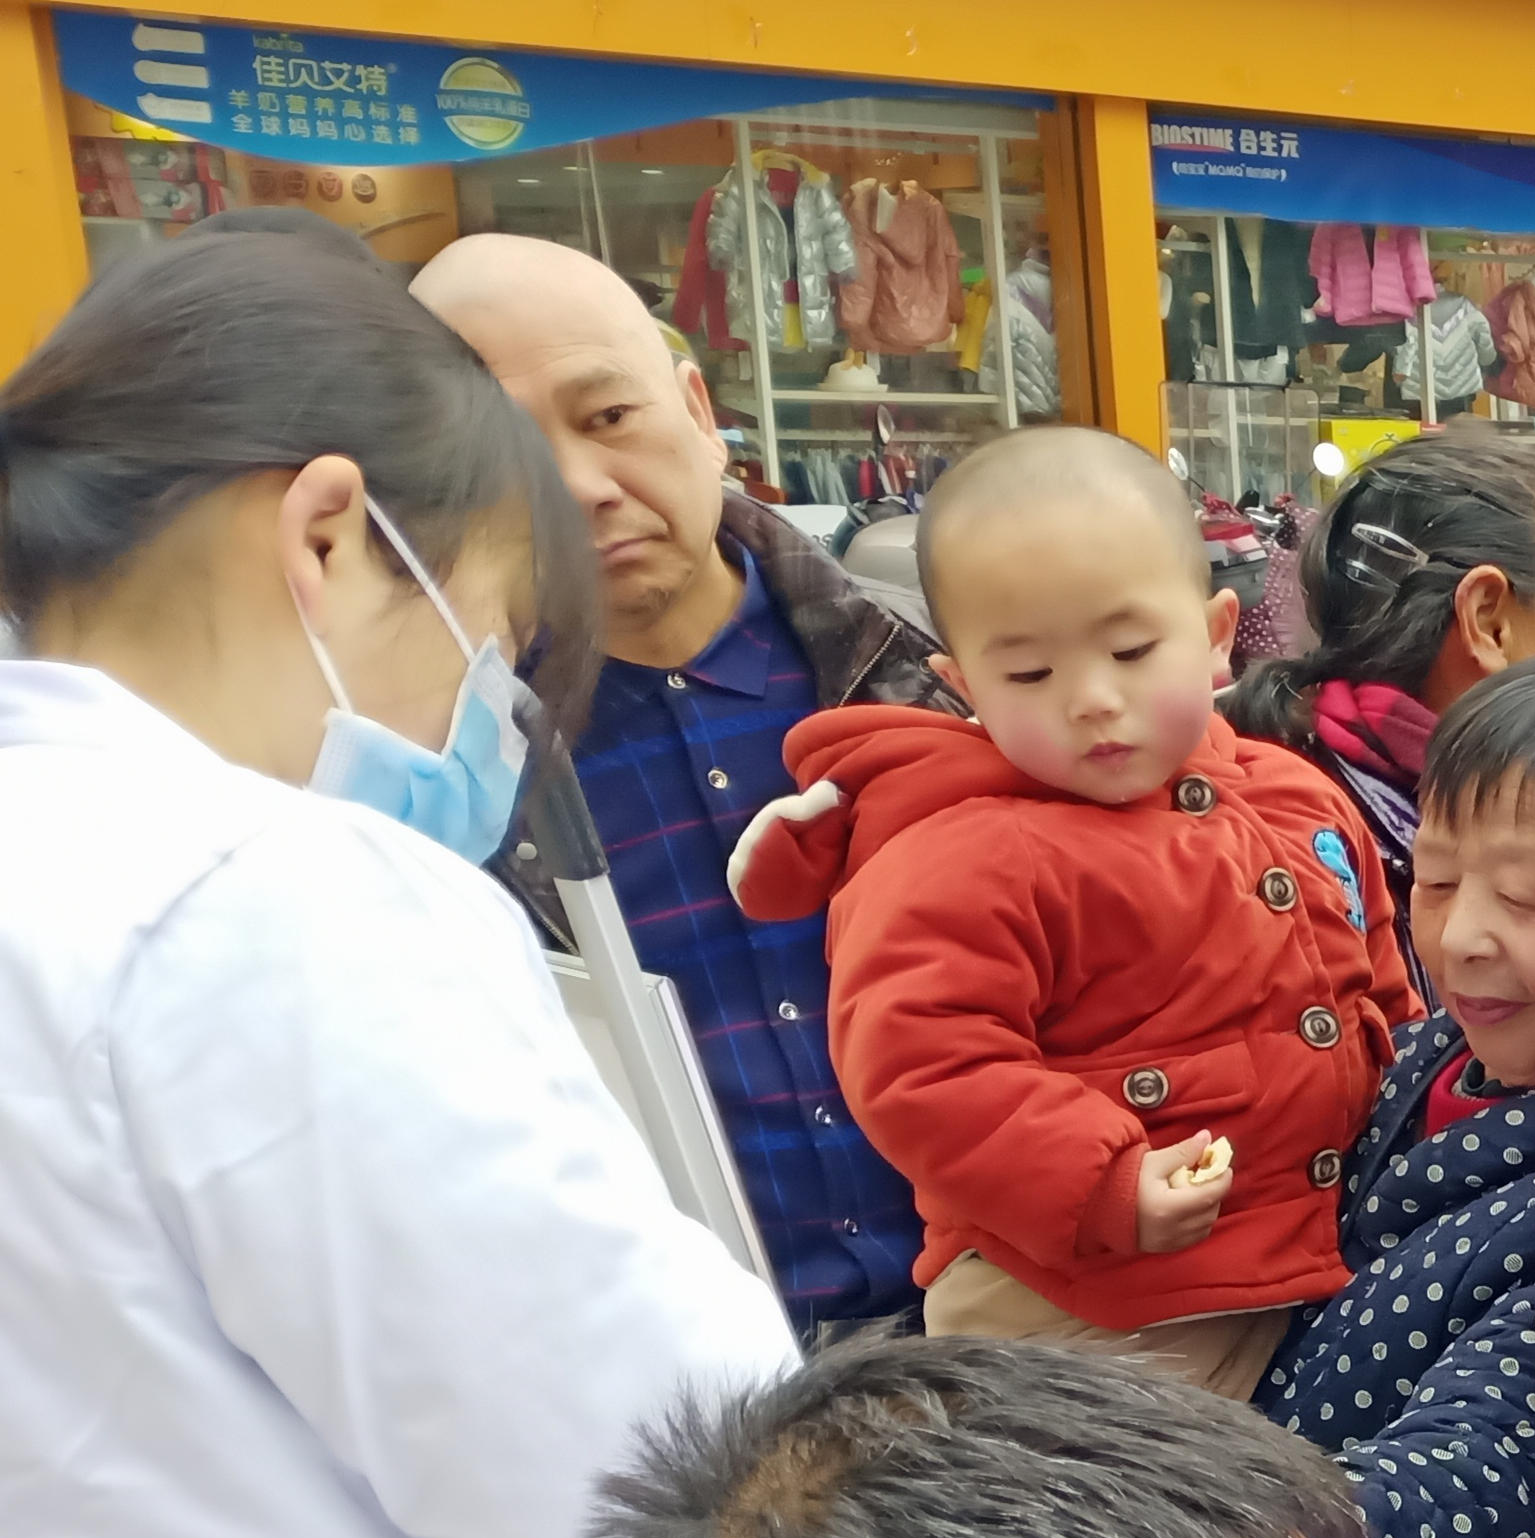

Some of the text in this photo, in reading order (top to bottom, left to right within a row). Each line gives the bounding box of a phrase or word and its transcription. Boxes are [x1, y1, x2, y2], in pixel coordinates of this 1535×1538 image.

[252, 54, 388, 96] 佳贝艾特
[228, 88, 418, 124] 羊奶营养高标准
[230, 112, 420, 145] 全球妈妈心选择
[1150, 123, 1300, 158] BIOSTIME 合生元
